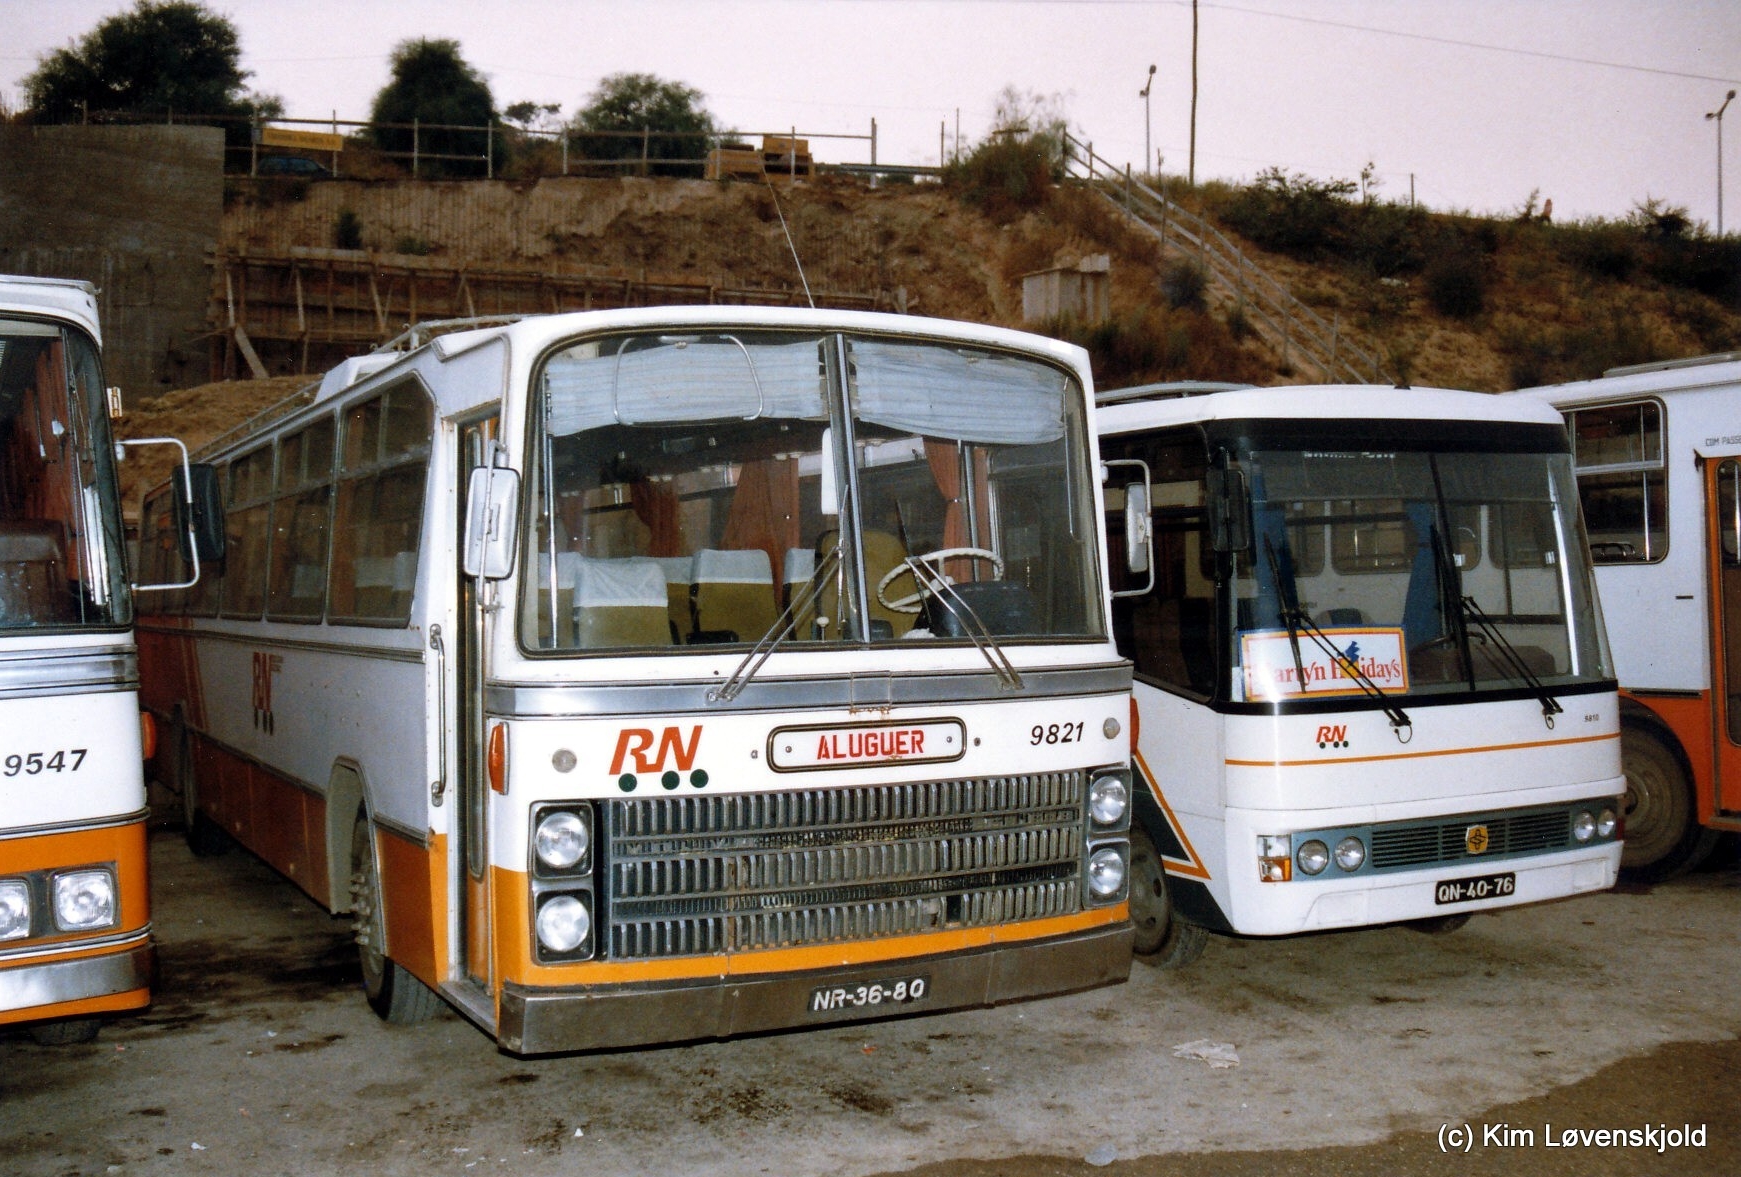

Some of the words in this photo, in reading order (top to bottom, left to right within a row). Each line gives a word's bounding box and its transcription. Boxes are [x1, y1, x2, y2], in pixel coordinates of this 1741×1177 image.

[1255, 659, 1326, 686] aryn
[1330, 656, 1401, 683] Hidays
[816, 729, 925, 760] ALUGUER
[1030, 721, 1084, 746] 9821
[1316, 725, 1347, 743] RN
[3, 748, 88, 777] 9547
[609, 724, 703, 775] RN
[1438, 877, 1513, 902] QN-40-76
[813, 978, 925, 1011] NR-36-80
